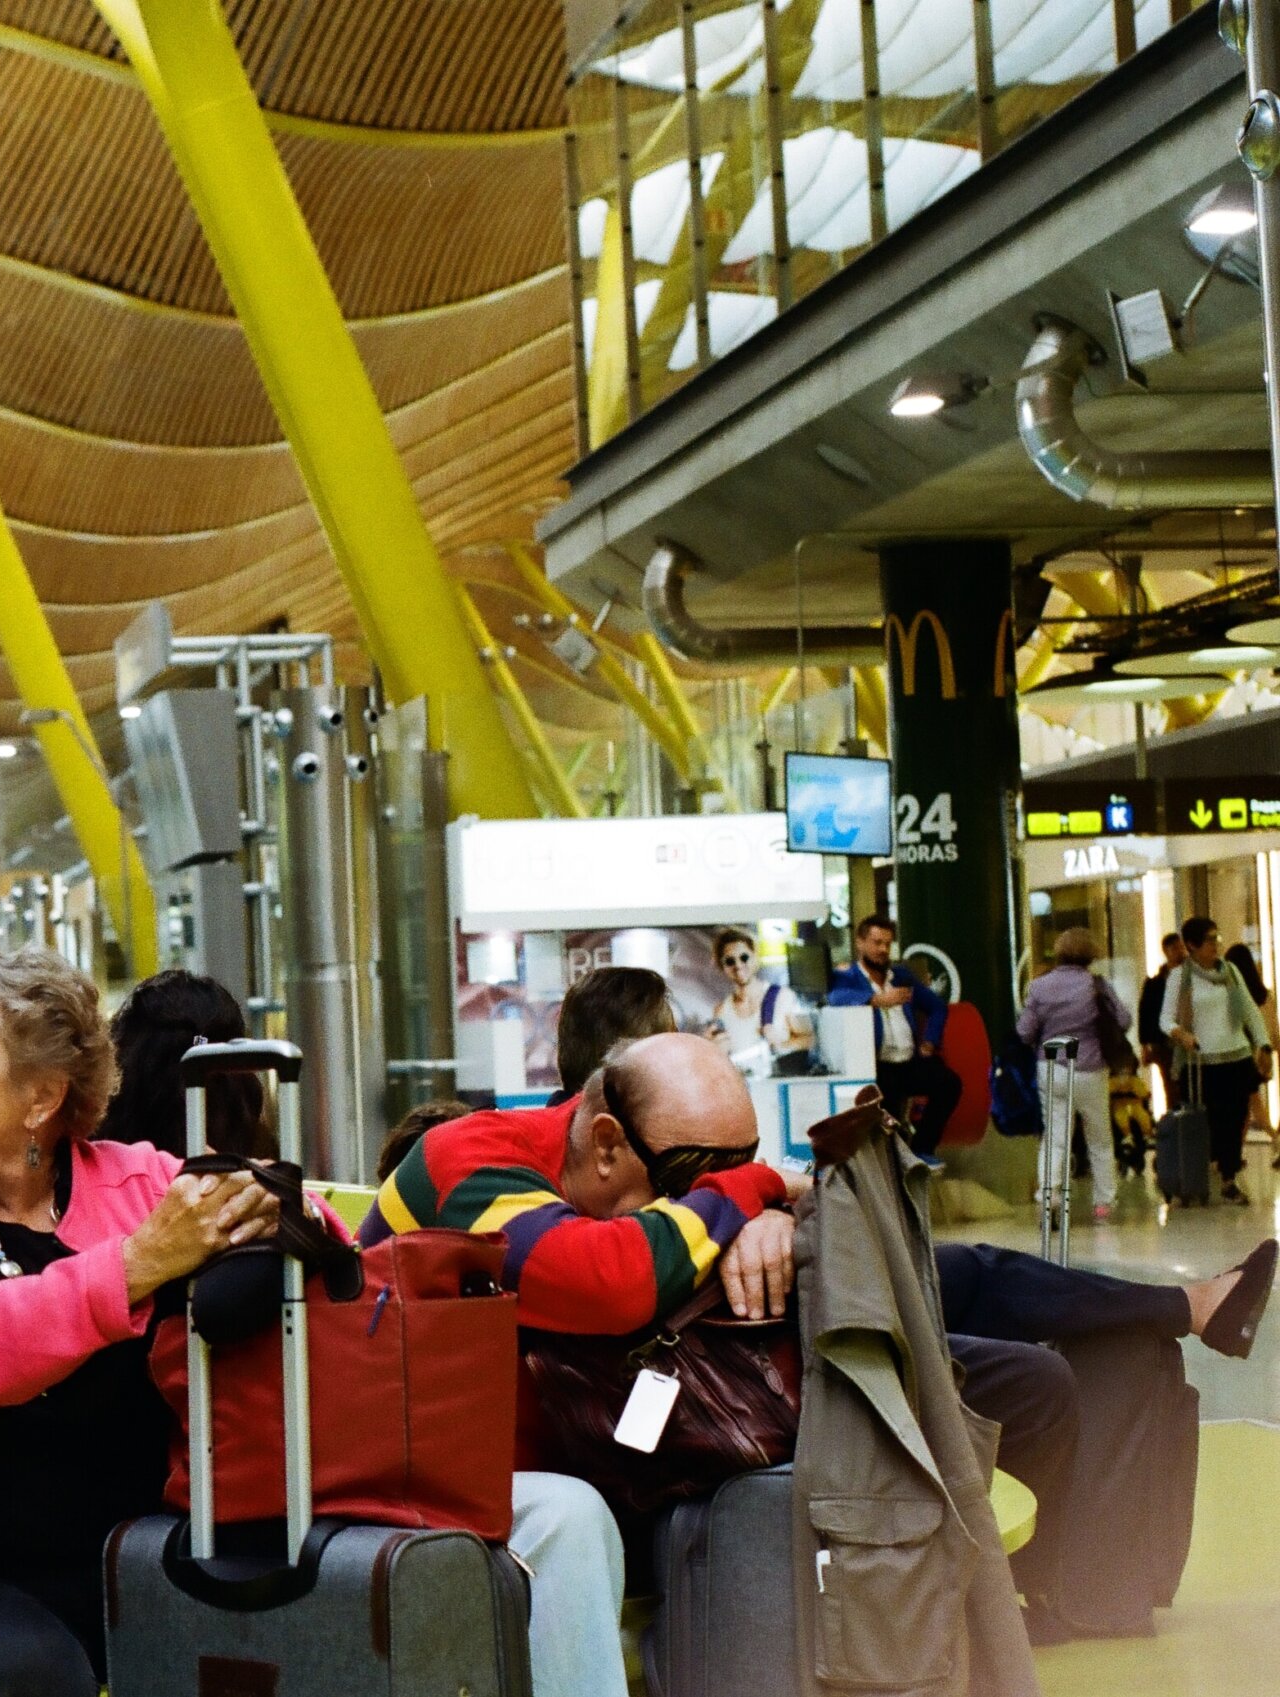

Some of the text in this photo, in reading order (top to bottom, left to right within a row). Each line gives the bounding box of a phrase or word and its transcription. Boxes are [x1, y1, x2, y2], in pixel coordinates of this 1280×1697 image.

[897, 792, 957, 844] 24
[1111, 806, 1128, 829] K
[896, 843, 959, 864] HORAS
[1063, 846, 1119, 878] ZARA
